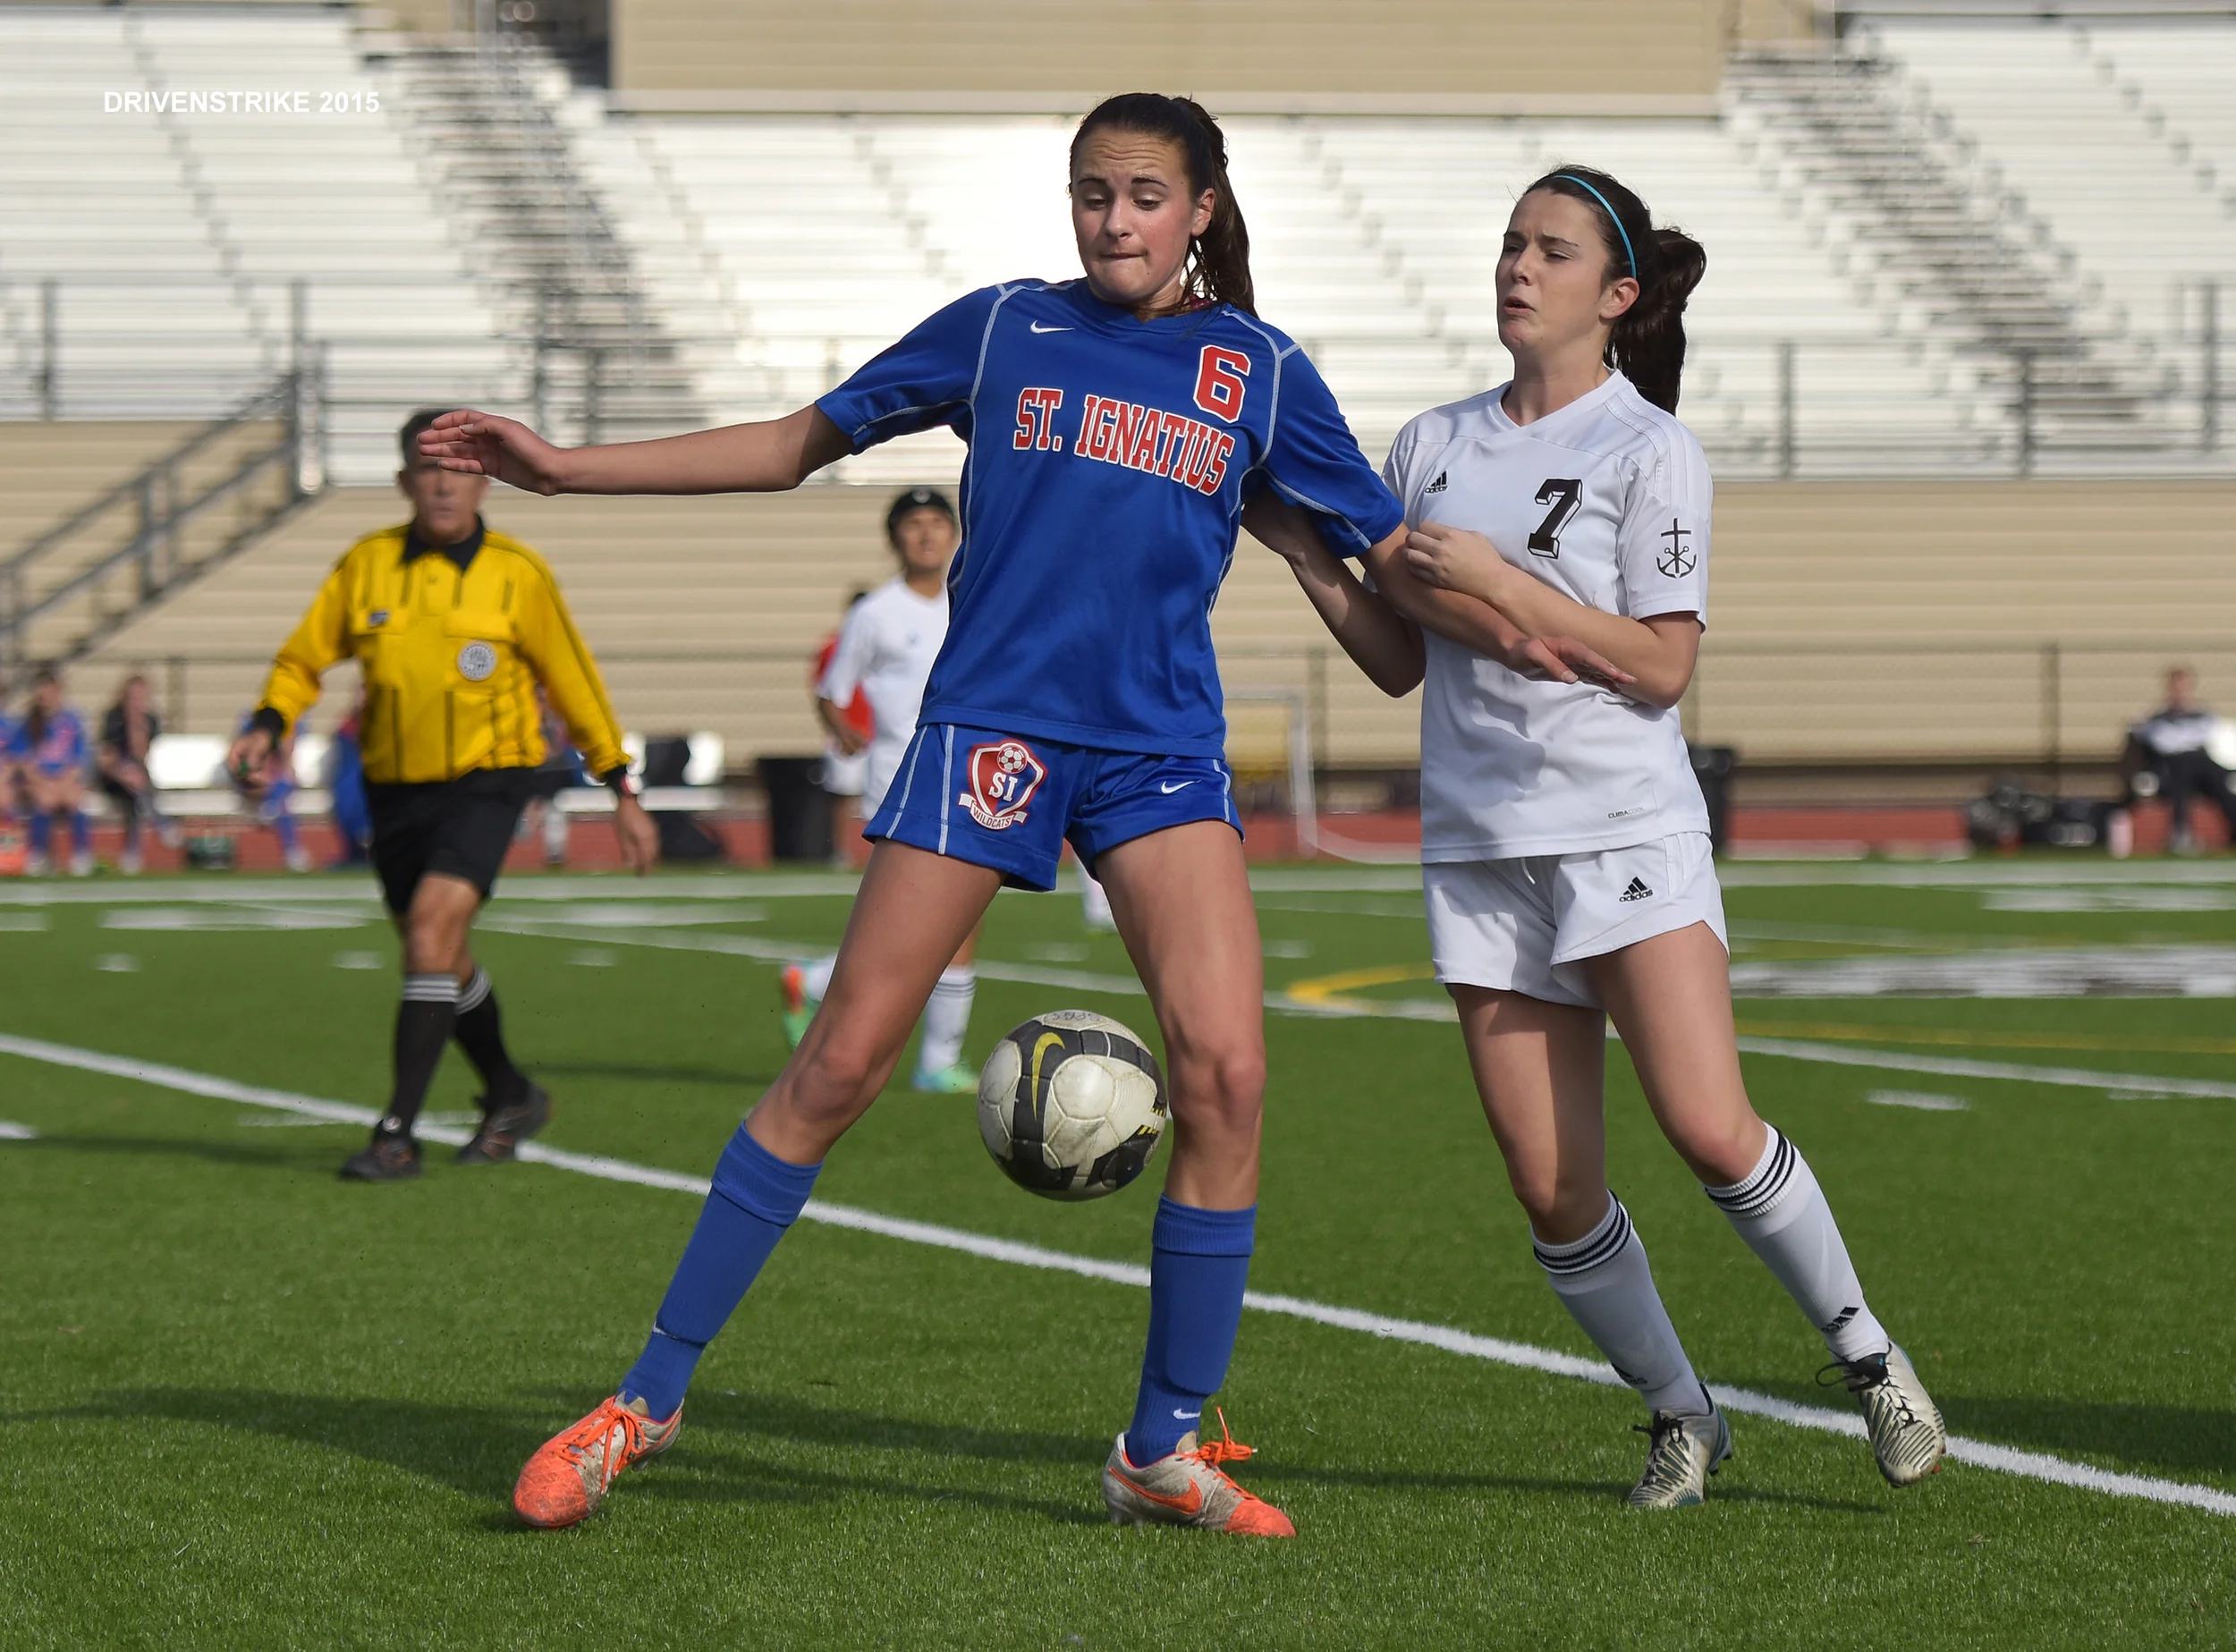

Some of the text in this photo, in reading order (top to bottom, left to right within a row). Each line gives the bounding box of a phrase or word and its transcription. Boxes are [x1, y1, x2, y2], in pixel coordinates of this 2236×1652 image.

[1193, 344, 1252, 424] 6
[1012, 387, 1236, 497] ST. IGNATIUS
[1527, 478, 1583, 560] 7
[988, 772, 1018, 801] SI
[972, 807, 1012, 828] WILDCATS
[1619, 889, 1654, 902] adidas
